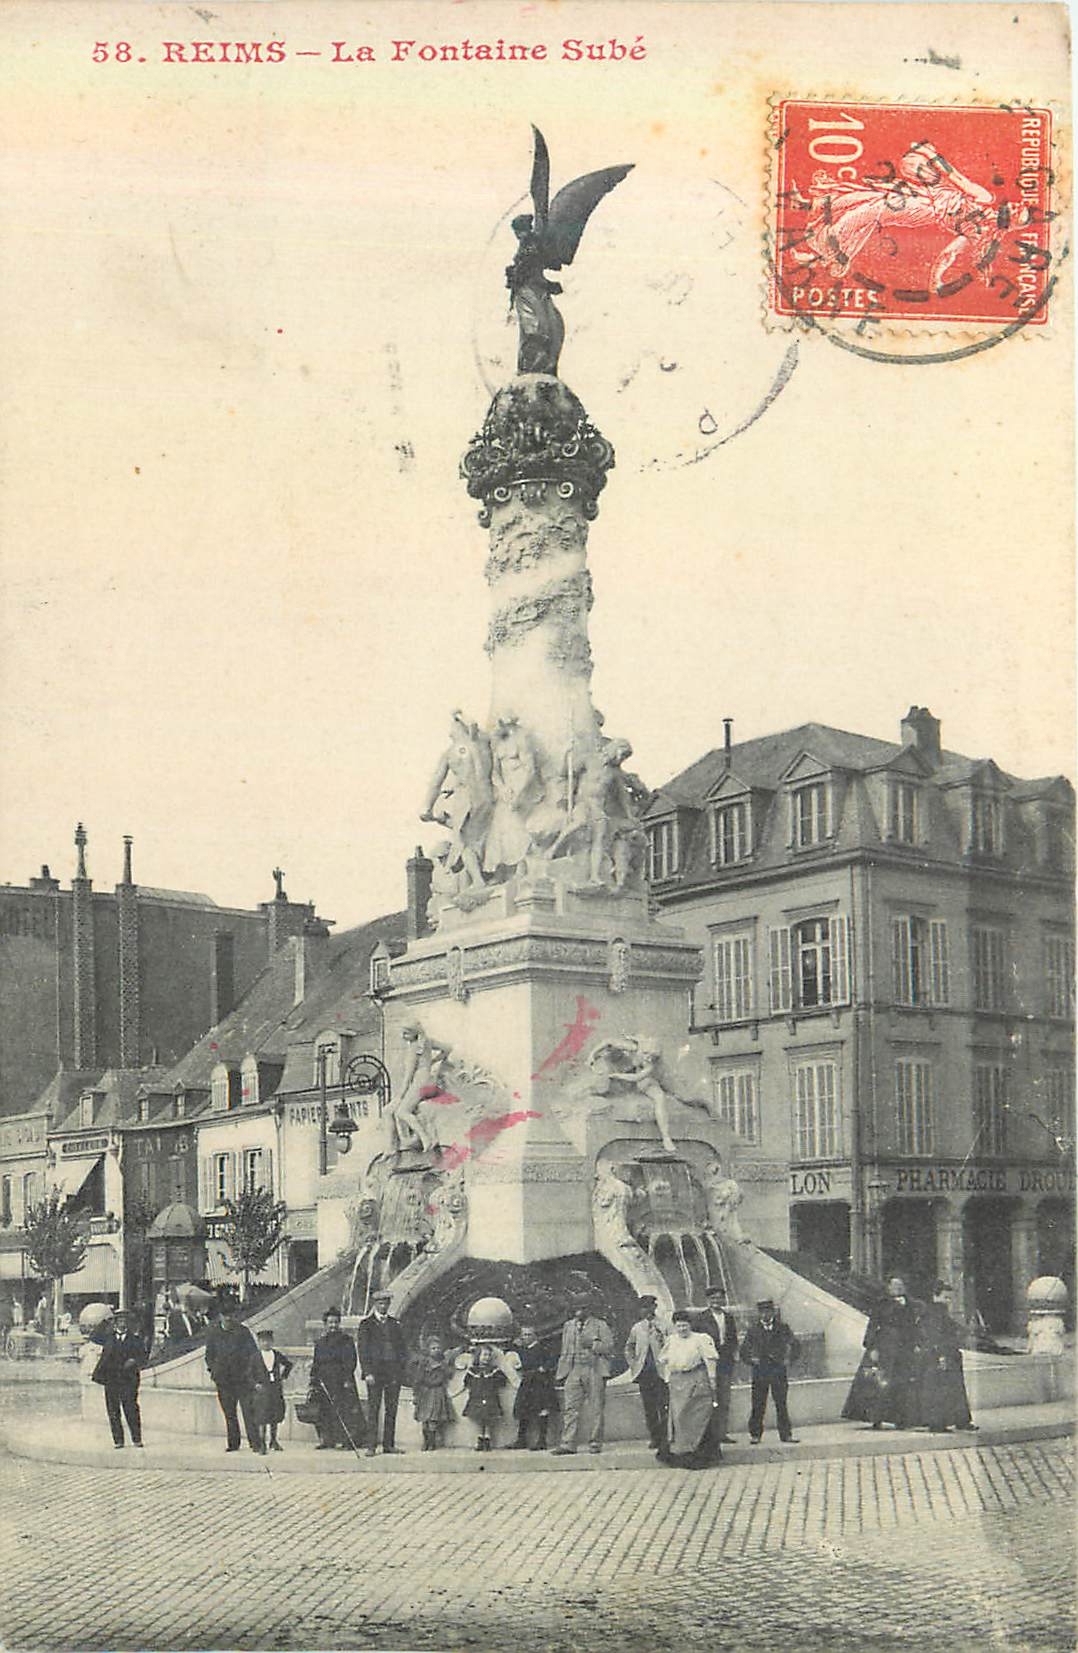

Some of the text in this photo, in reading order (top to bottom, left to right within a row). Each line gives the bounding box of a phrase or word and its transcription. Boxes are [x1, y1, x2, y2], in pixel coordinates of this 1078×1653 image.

[807, 112, 865, 165] 10
[791, 286, 879, 309] POSTES
[896, 1168, 1007, 1192] PHARMACIE
